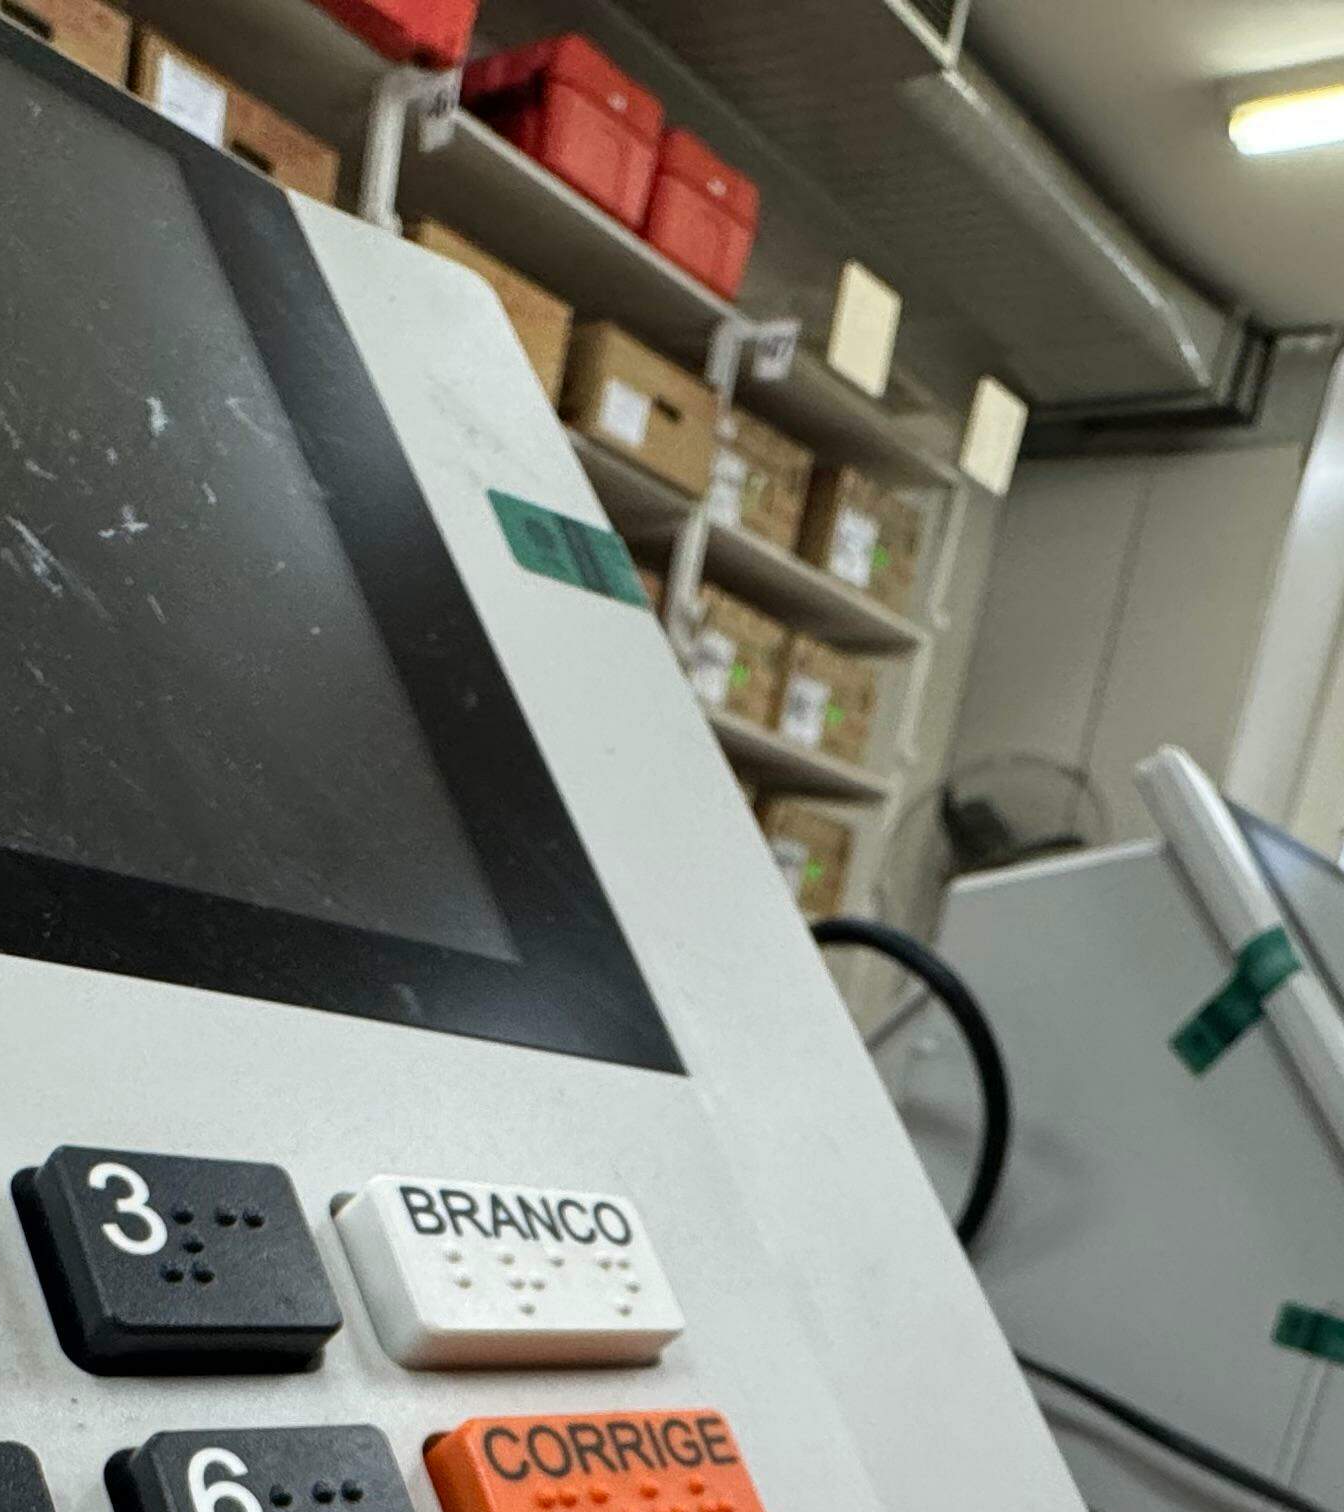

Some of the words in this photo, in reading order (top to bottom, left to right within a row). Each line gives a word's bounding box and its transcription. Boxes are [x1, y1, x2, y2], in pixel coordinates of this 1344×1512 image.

[89, 1163, 167, 1255] 3
[399, 1185, 632, 1247] BRANCO
[482, 1417, 738, 1481] CORRIGE
